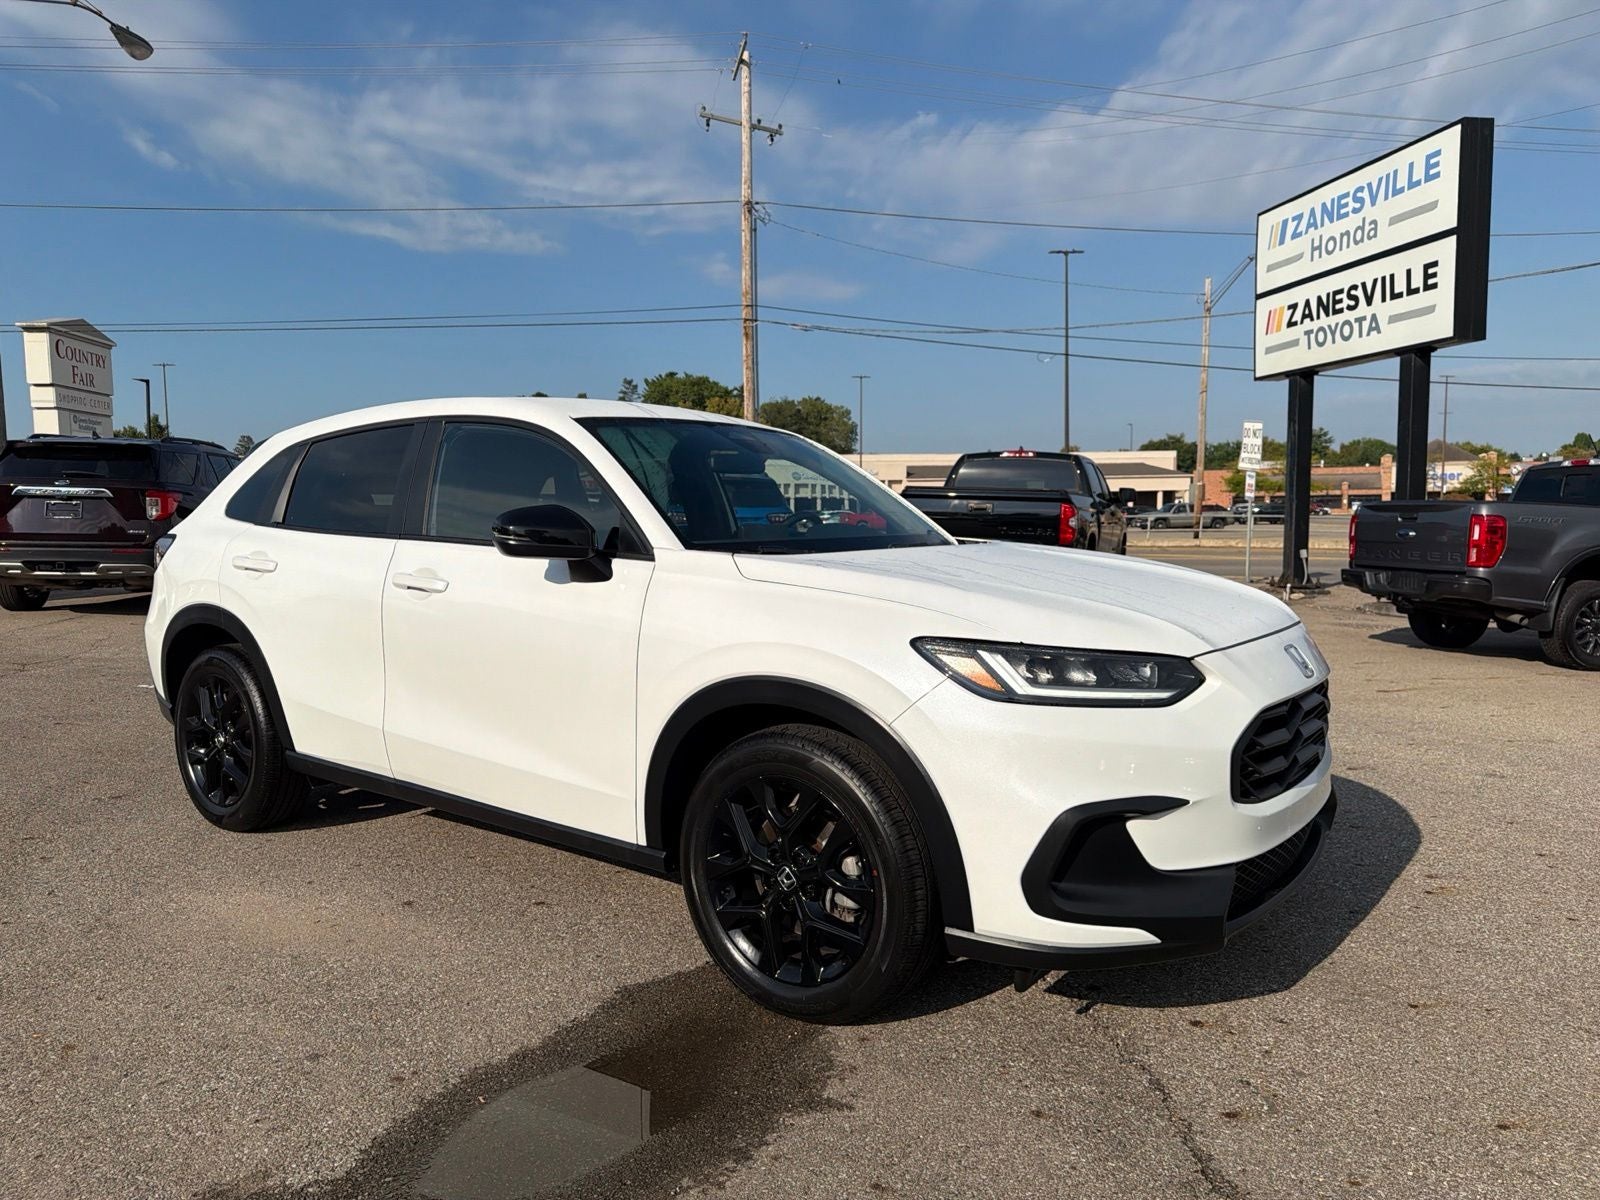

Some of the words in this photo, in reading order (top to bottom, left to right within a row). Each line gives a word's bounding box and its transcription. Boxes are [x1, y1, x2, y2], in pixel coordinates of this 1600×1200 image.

[1290, 148, 1442, 241] ZANESVILLE
[1310, 216, 1379, 262] Honda
[1286, 259, 1439, 329] ZANESVILLE
[1304, 313, 1382, 350] TOYOTA
[55, 338, 107, 369] COUNTRY
[71, 365, 96, 388] FAIR
[58, 393, 88, 407] SHOPPING
[90, 398, 111, 410] CENTER
